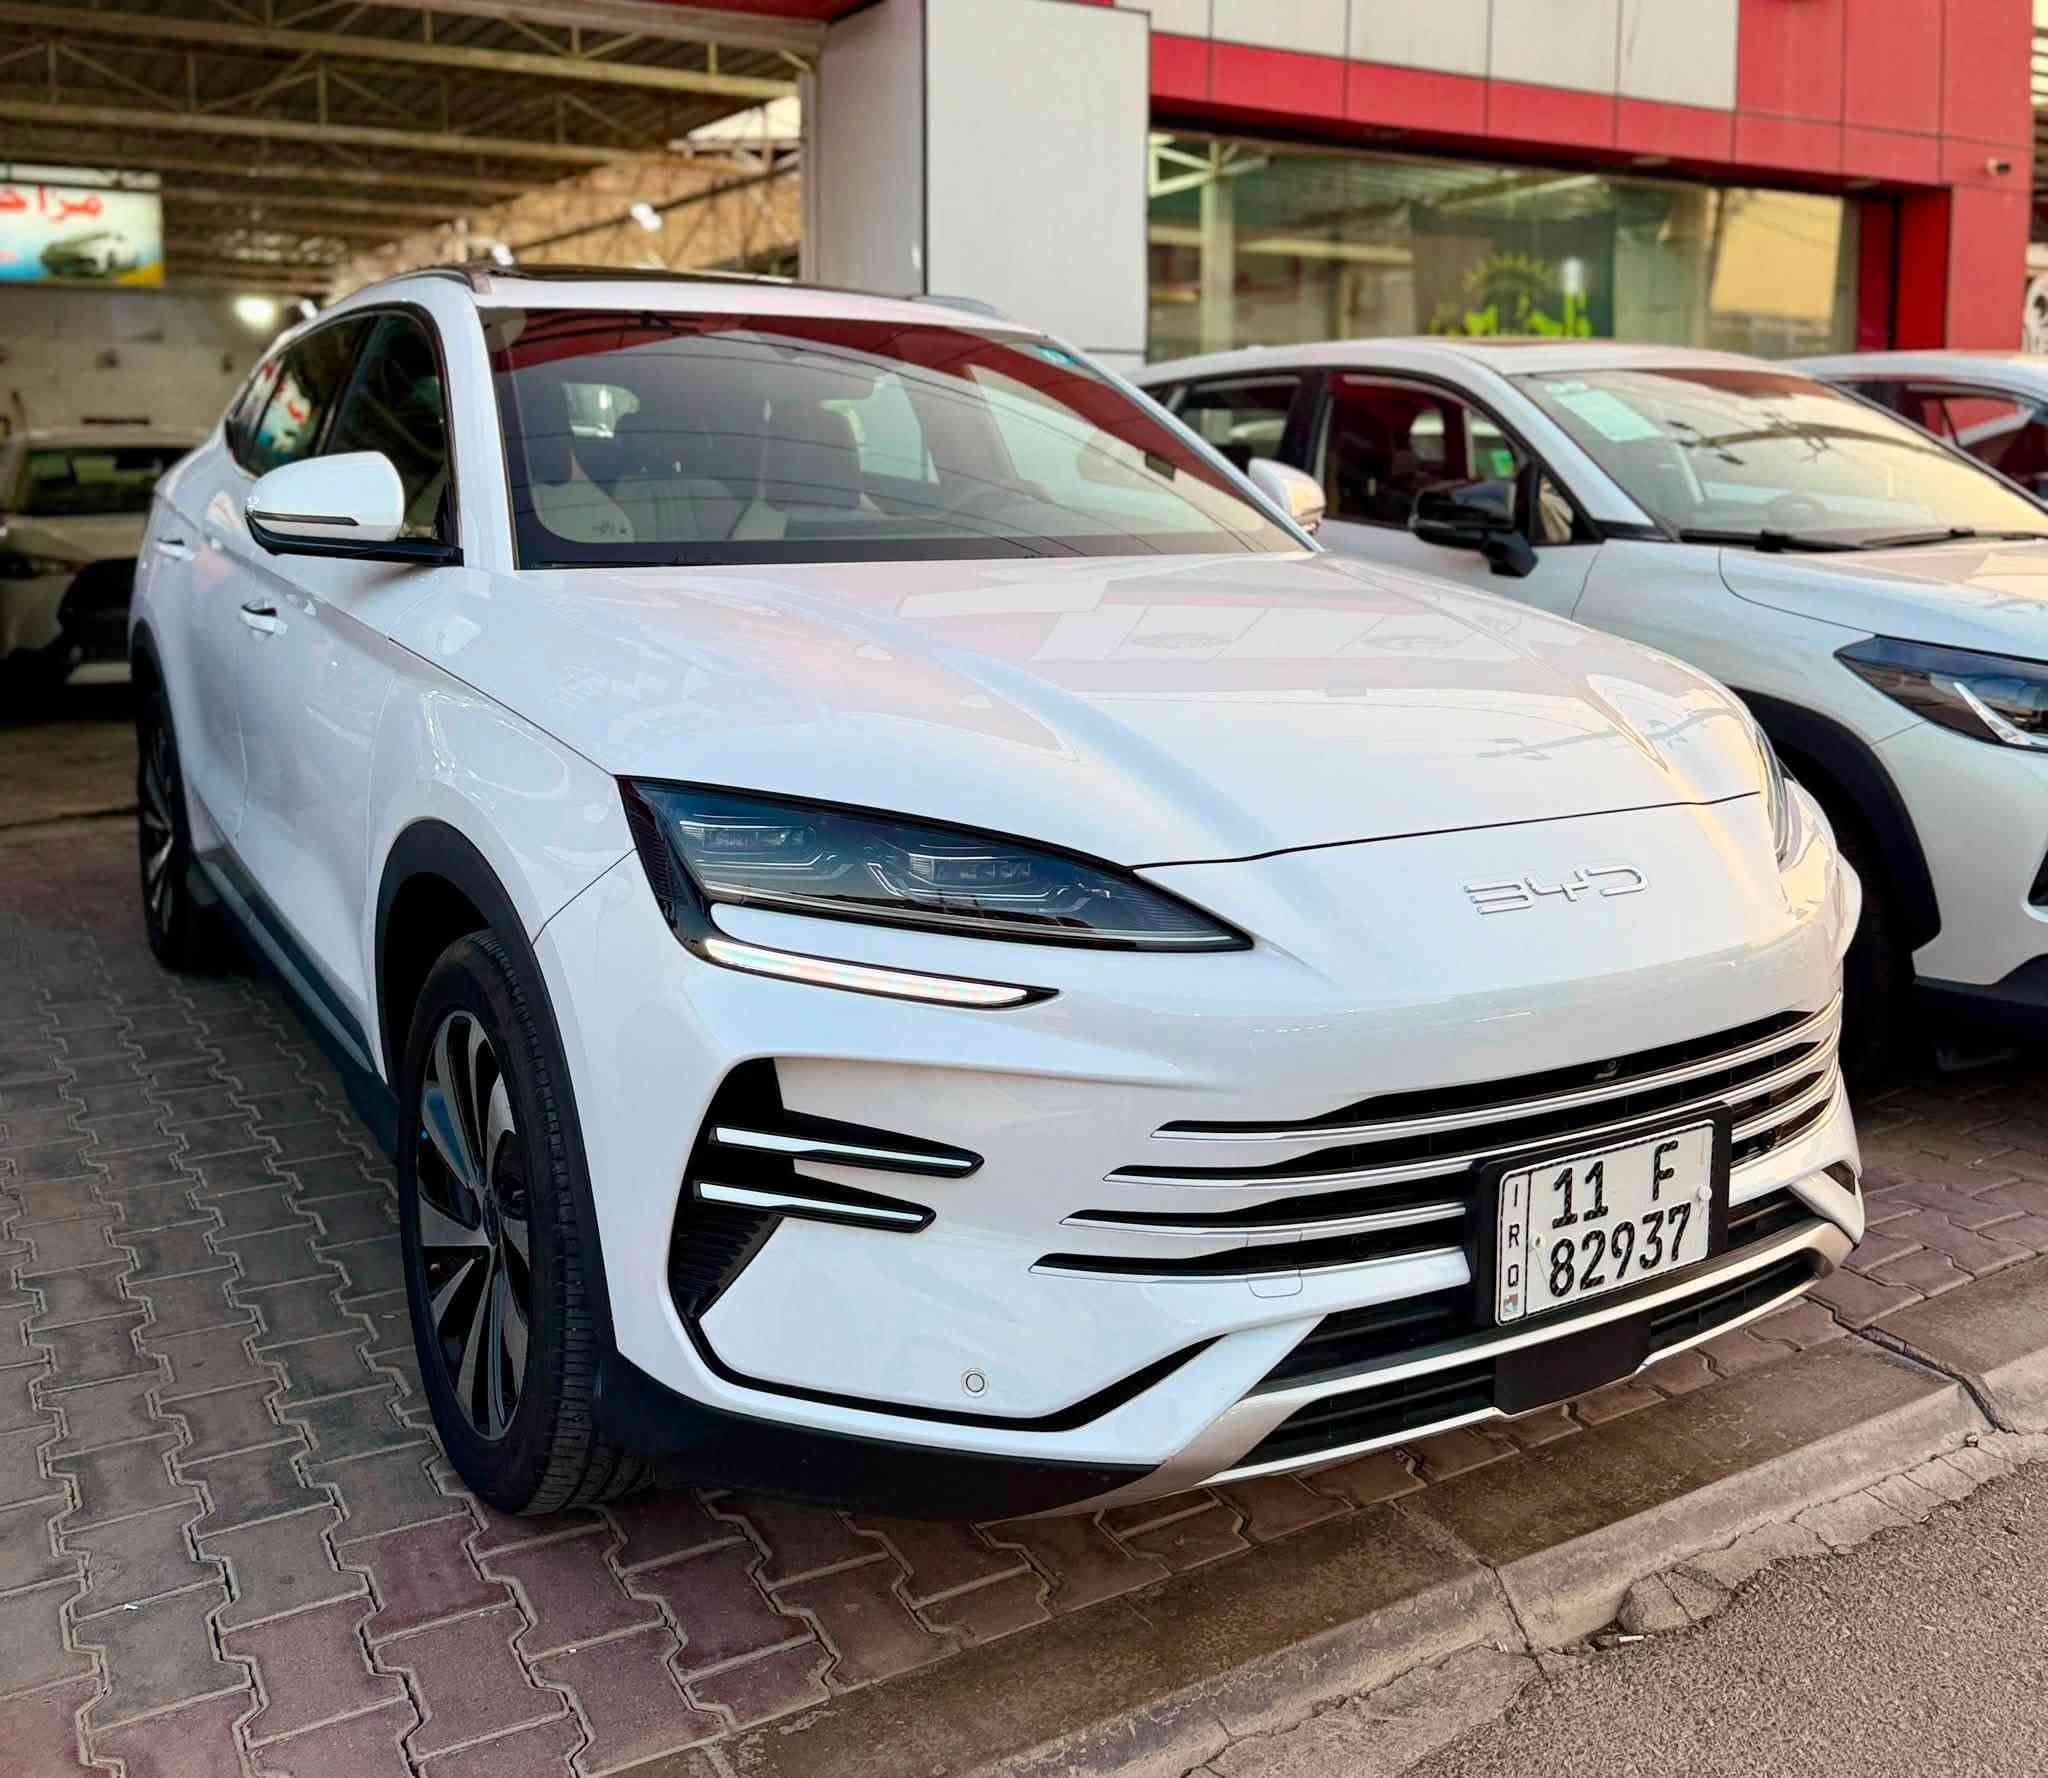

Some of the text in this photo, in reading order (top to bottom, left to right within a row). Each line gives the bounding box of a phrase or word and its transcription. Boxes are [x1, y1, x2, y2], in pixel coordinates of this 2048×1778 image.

[1463, 863, 1649, 916] BYD
[1551, 1139, 1679, 1229] 11 F
[1549, 1201, 1692, 1297] 82937
